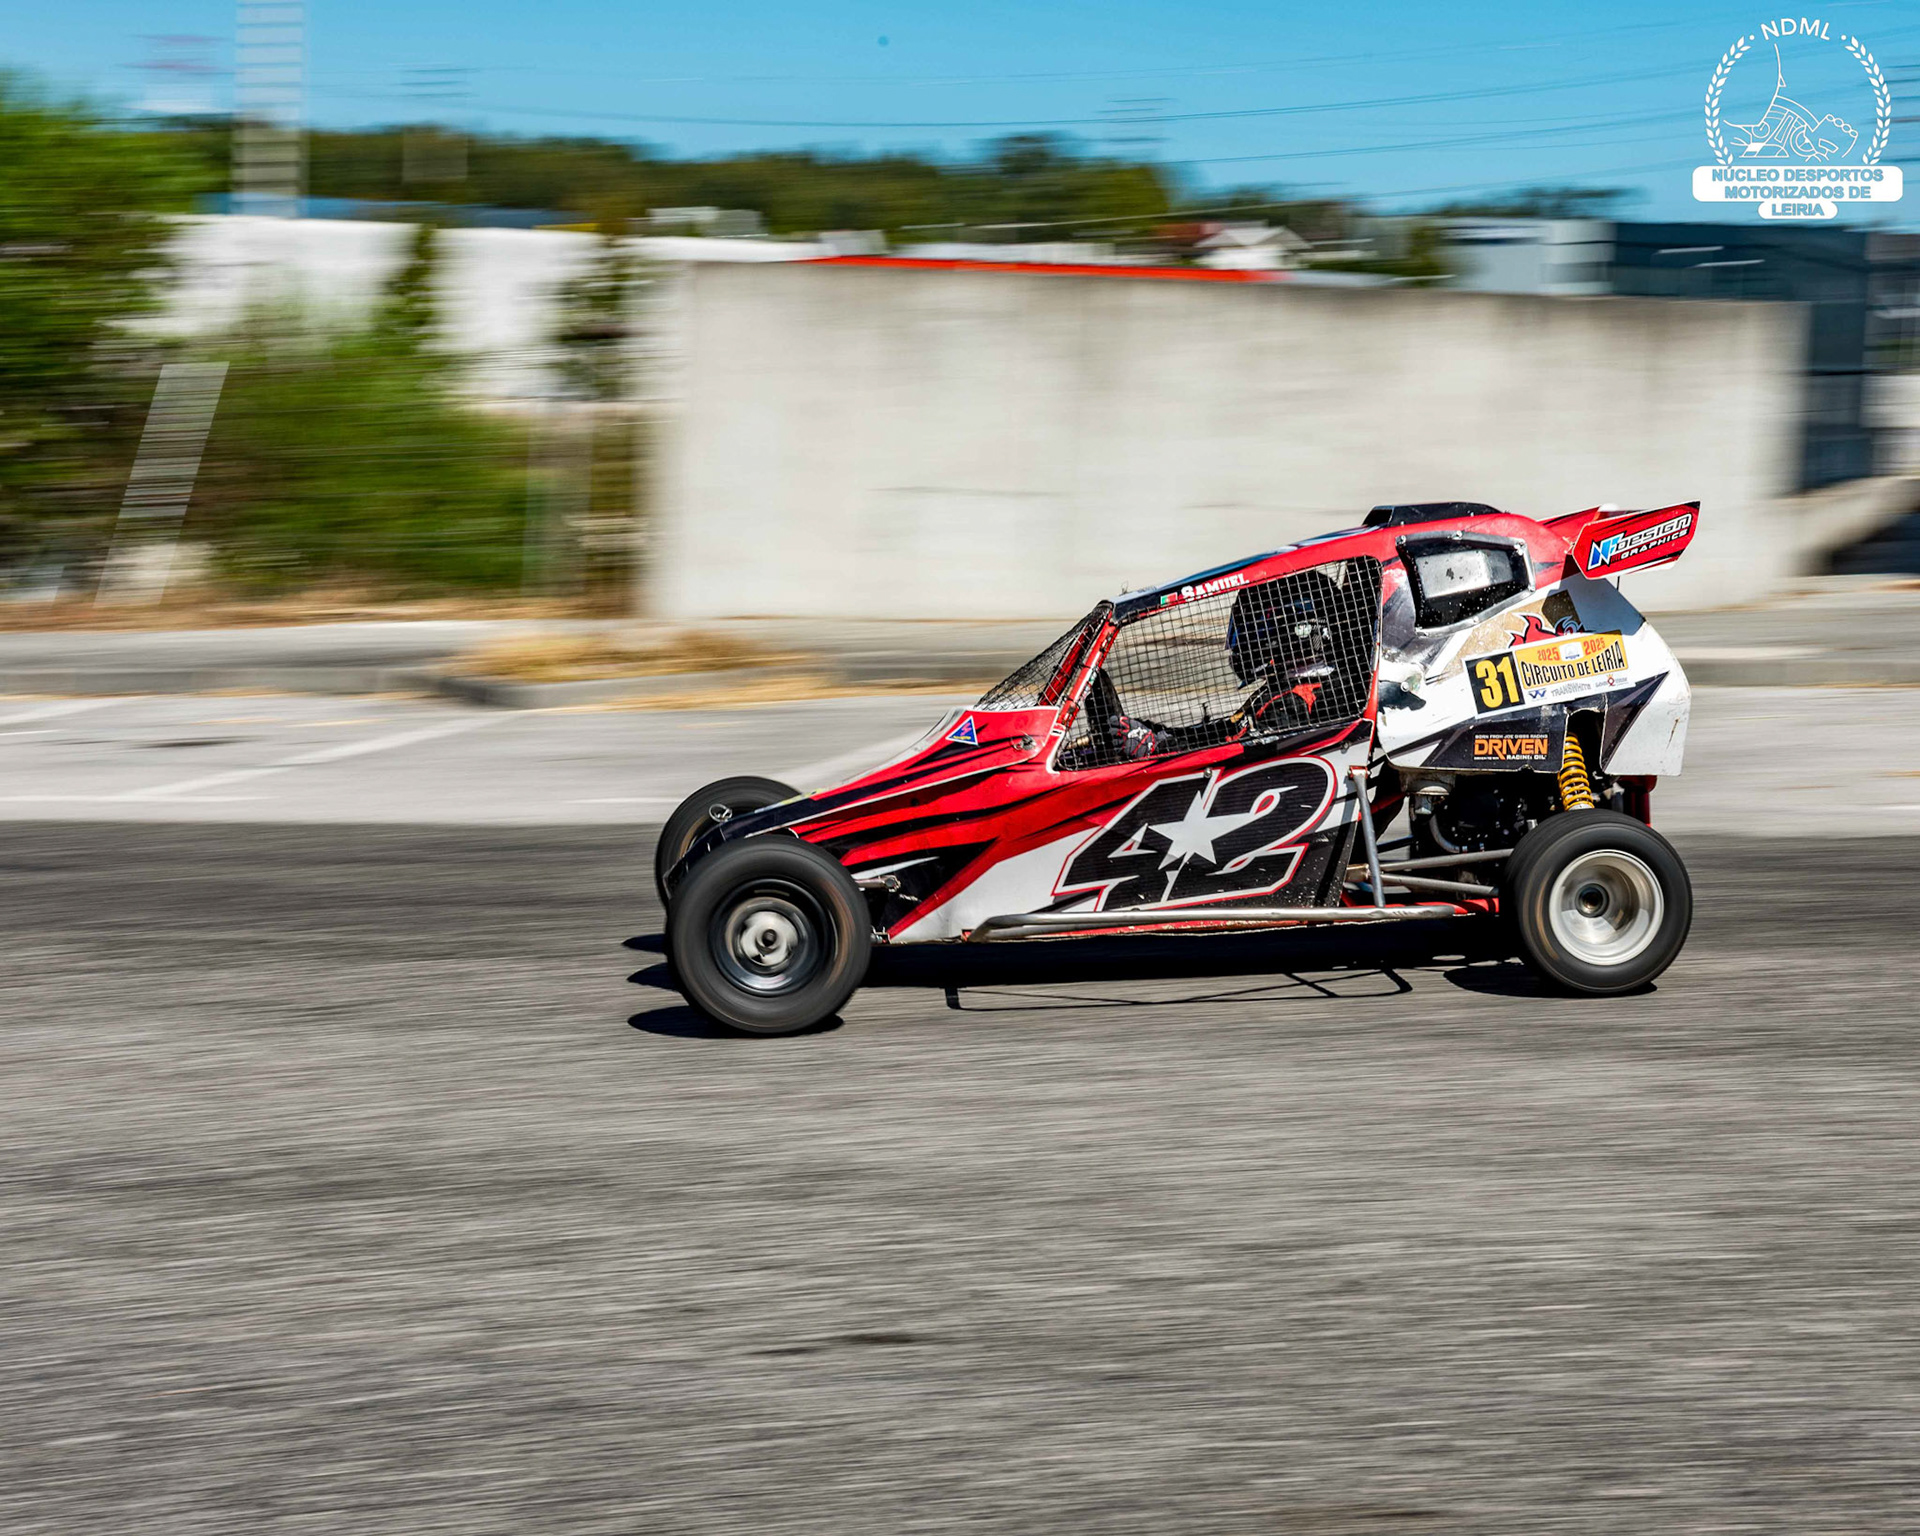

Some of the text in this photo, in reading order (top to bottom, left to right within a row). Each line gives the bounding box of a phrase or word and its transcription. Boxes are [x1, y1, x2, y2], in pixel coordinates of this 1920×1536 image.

[1620, 528, 1689, 560] GRAPHICS
[1181, 573, 1249, 602] SAMUEL
[1521, 660, 1575, 687] CIRCUITO
[1576, 661, 1591, 676] DE
[1591, 640, 1625, 673] LEIRIA
[1537, 637, 1606, 661] 2025 2025
[1475, 656, 1520, 708] 31
[1474, 738, 1548, 760] DRIVEN
[1054, 756, 1336, 912] 42
